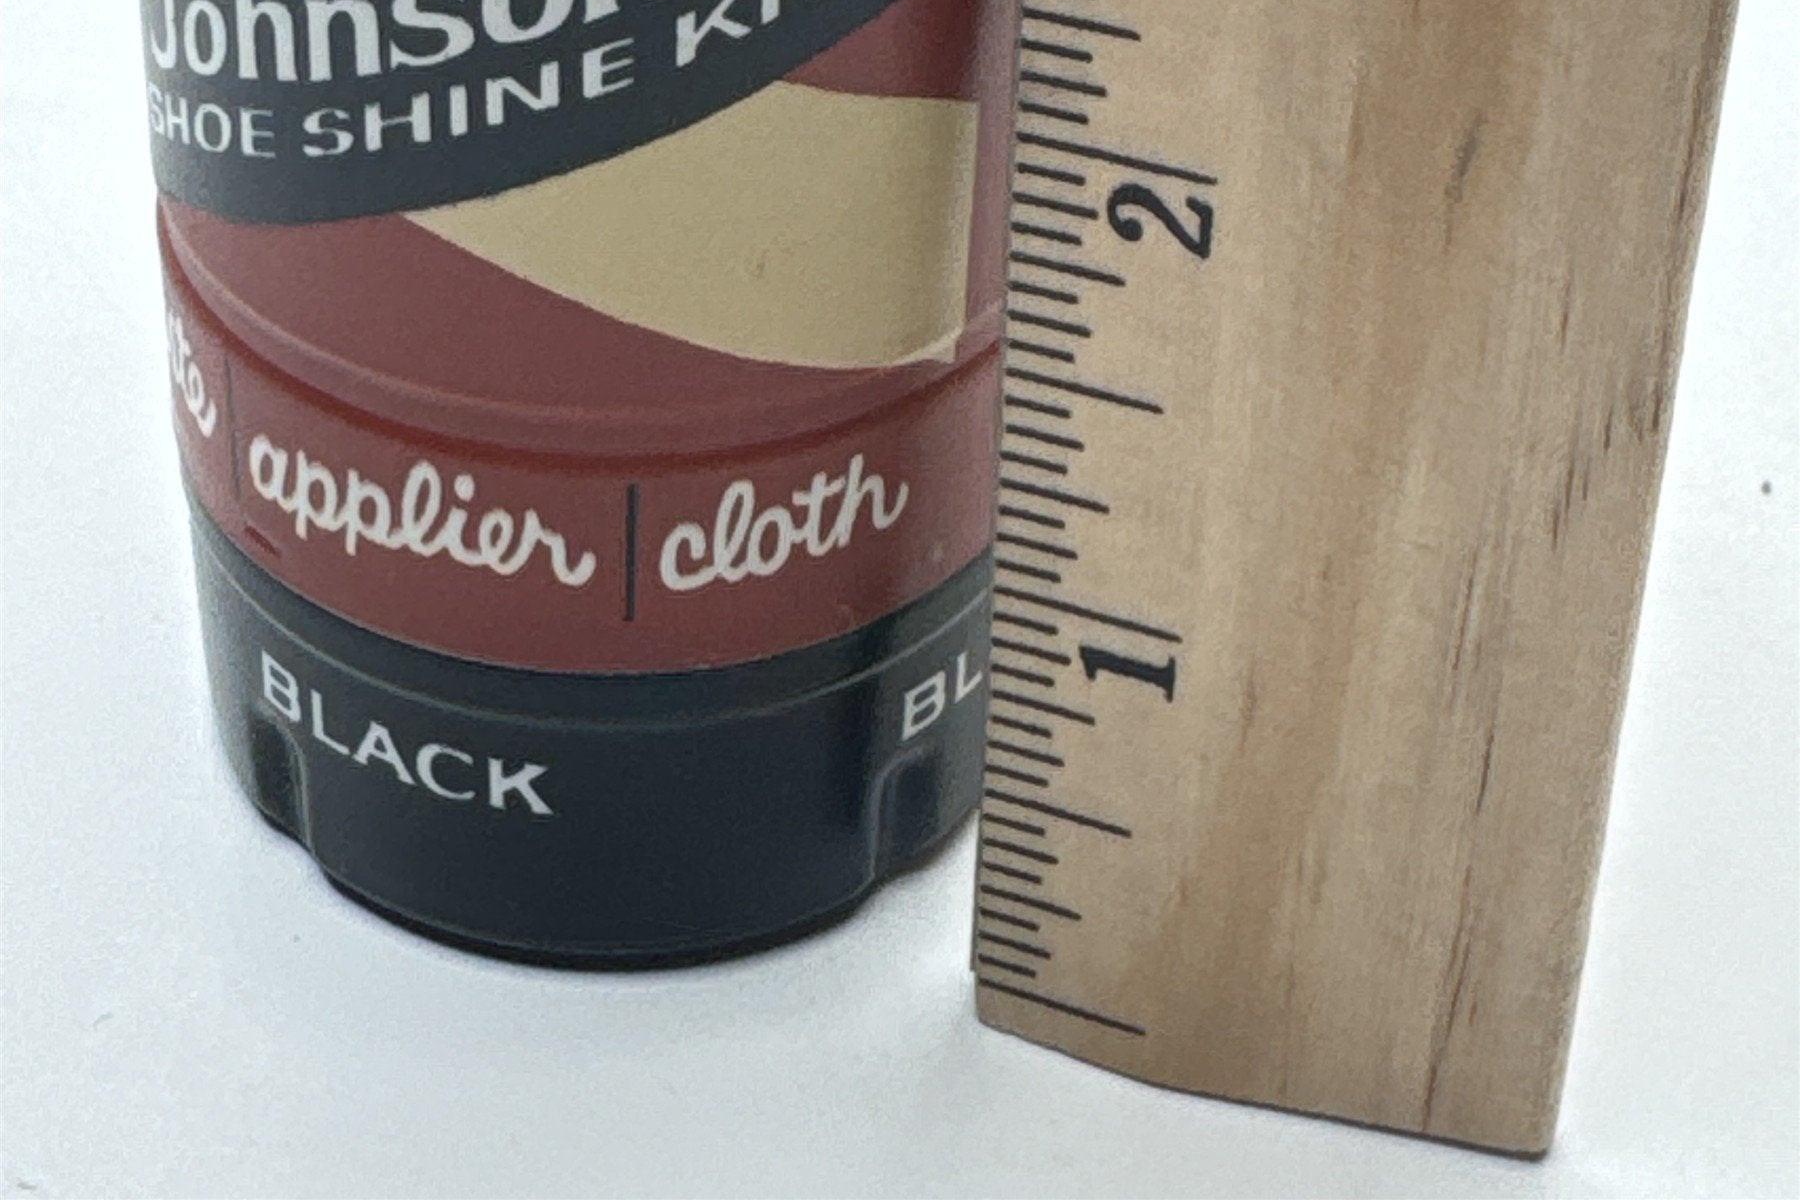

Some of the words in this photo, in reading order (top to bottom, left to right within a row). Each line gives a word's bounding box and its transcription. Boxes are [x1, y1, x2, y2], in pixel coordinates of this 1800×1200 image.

[147, 80, 277, 159] SHOE
[302, 37, 636, 159] SHINE
[1107, 182, 1213, 260] 2
[249, 433, 597, 588] applier
[658, 453, 908, 592] cloth
[260, 649, 554, 817] BLACK
[1076, 641, 1179, 704] 1
